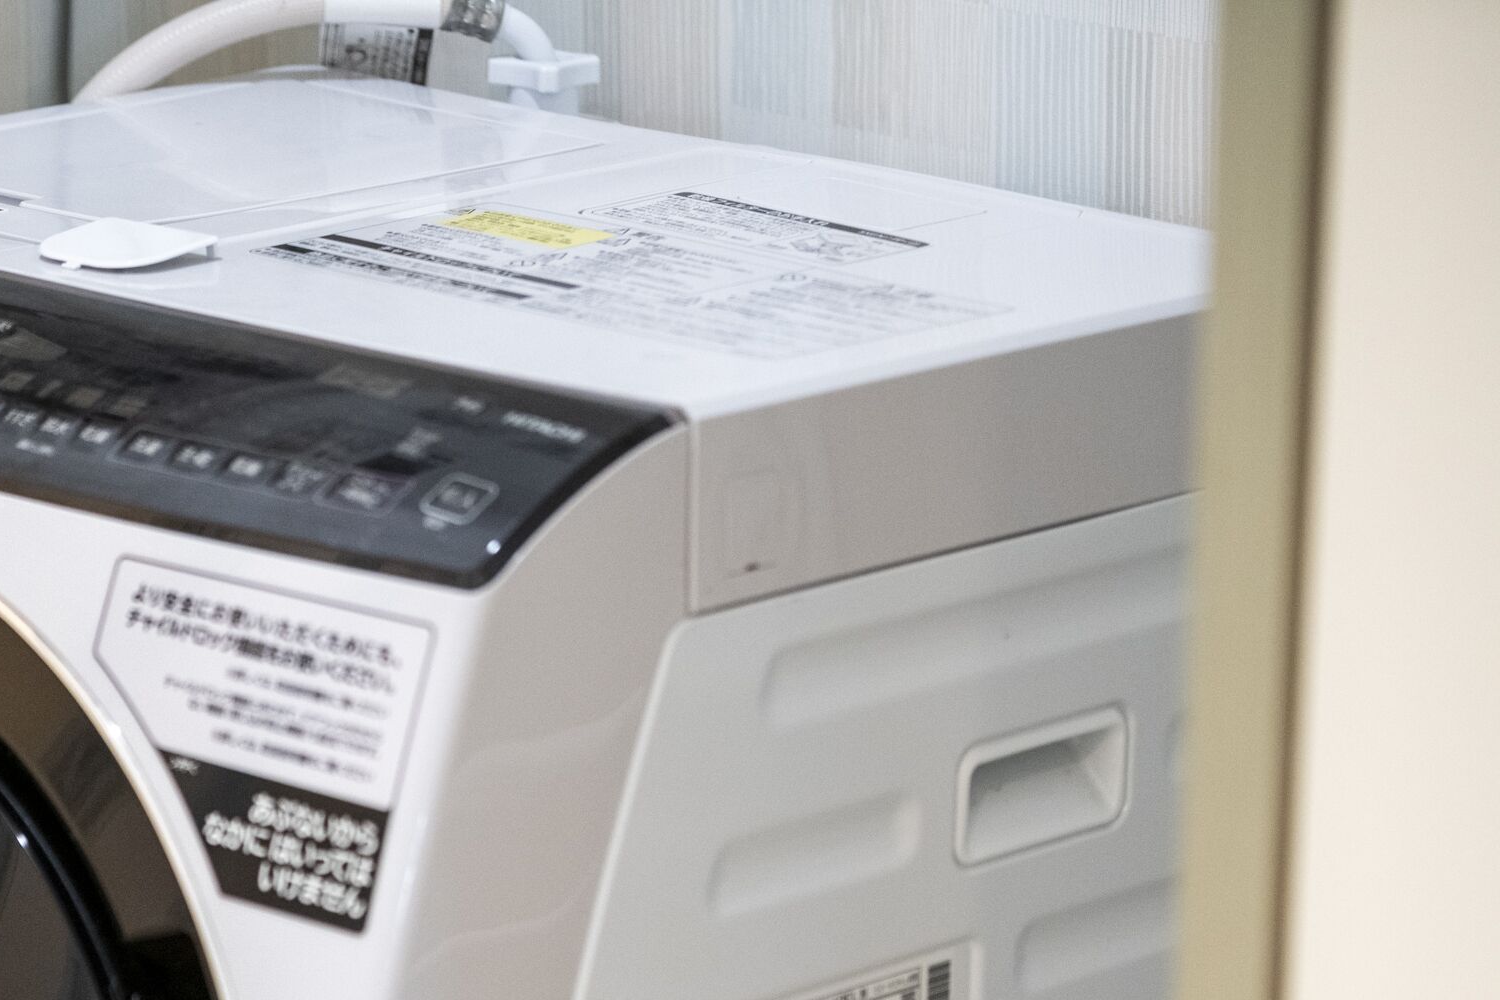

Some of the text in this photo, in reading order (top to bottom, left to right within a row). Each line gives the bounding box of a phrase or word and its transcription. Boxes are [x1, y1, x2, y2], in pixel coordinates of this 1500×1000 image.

[203, 811, 376, 888] なかにはいっては
[249, 791, 379, 856] あぶないから
[258, 862, 367, 921] いけません
